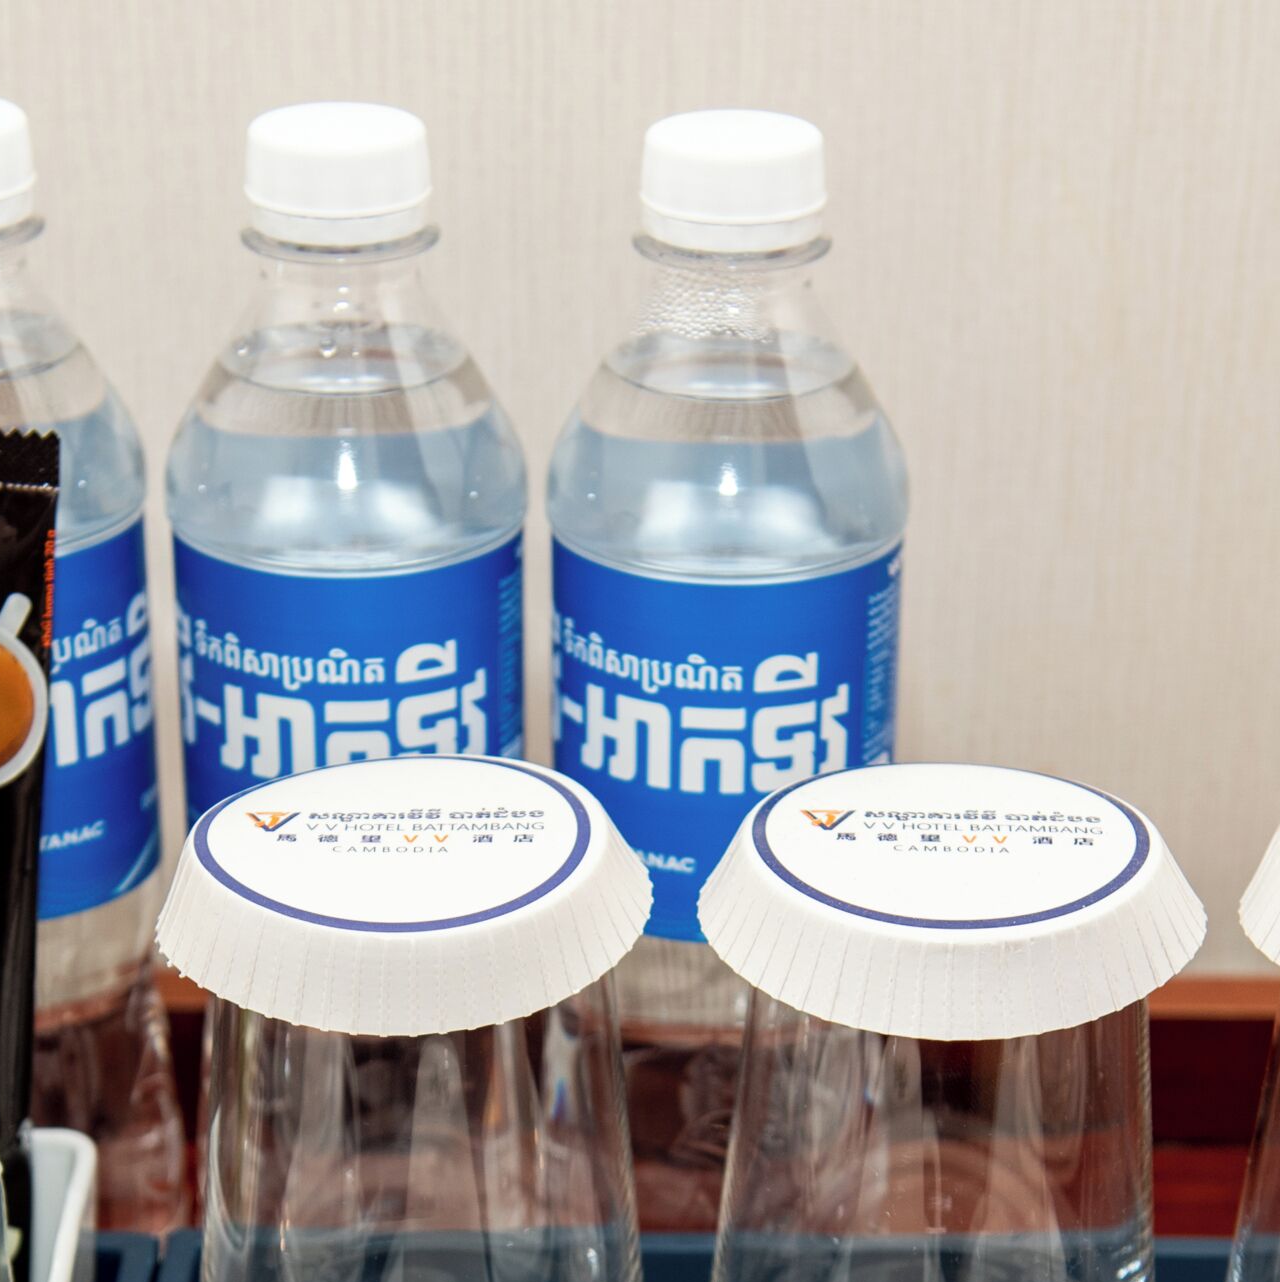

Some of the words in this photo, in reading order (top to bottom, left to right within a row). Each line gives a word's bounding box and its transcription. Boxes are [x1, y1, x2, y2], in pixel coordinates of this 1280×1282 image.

[345, 822, 406, 832] HOTEL
[413, 821, 545, 832] BATTAMBANG
[903, 823, 963, 832] HOTEL
[970, 823, 1104, 835] BATTAMBANG
[332, 845, 450, 854] CAMBODIA
[893, 845, 1011, 854] CAMBODIA
